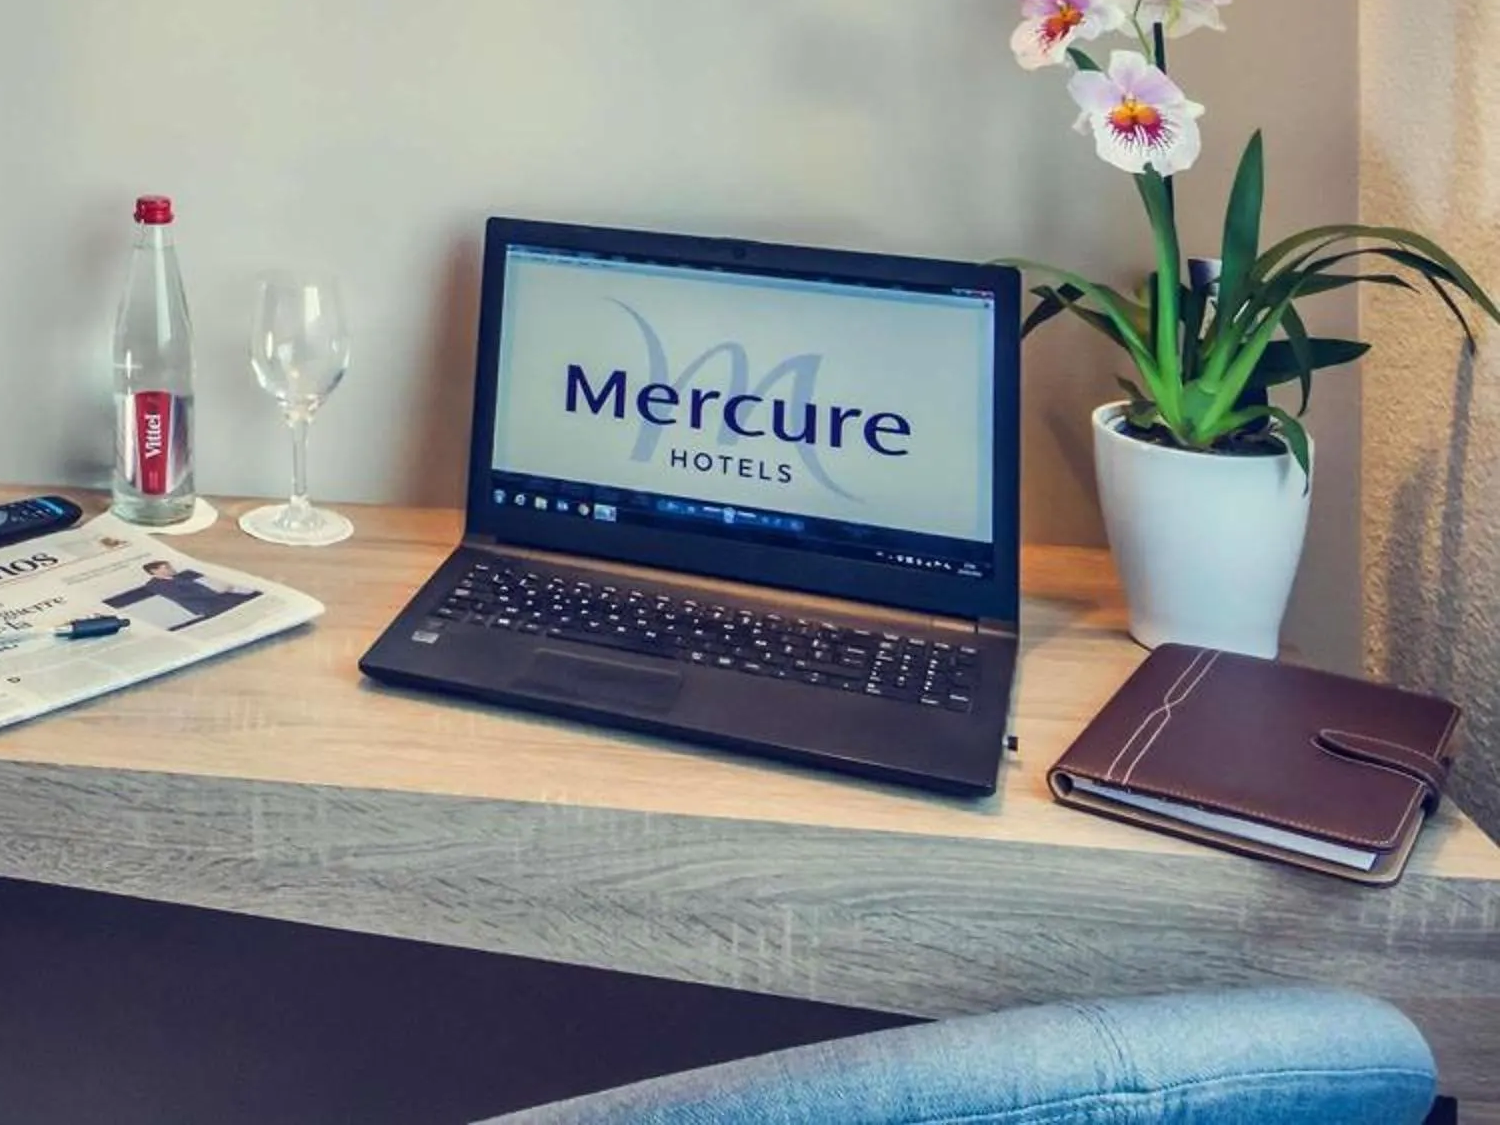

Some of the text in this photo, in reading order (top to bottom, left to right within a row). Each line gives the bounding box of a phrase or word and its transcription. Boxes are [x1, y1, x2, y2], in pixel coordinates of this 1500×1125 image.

[565, 364, 912, 457] Mercure
[144, 414, 162, 459] Vittel
[671, 448, 793, 484] HOTELS
